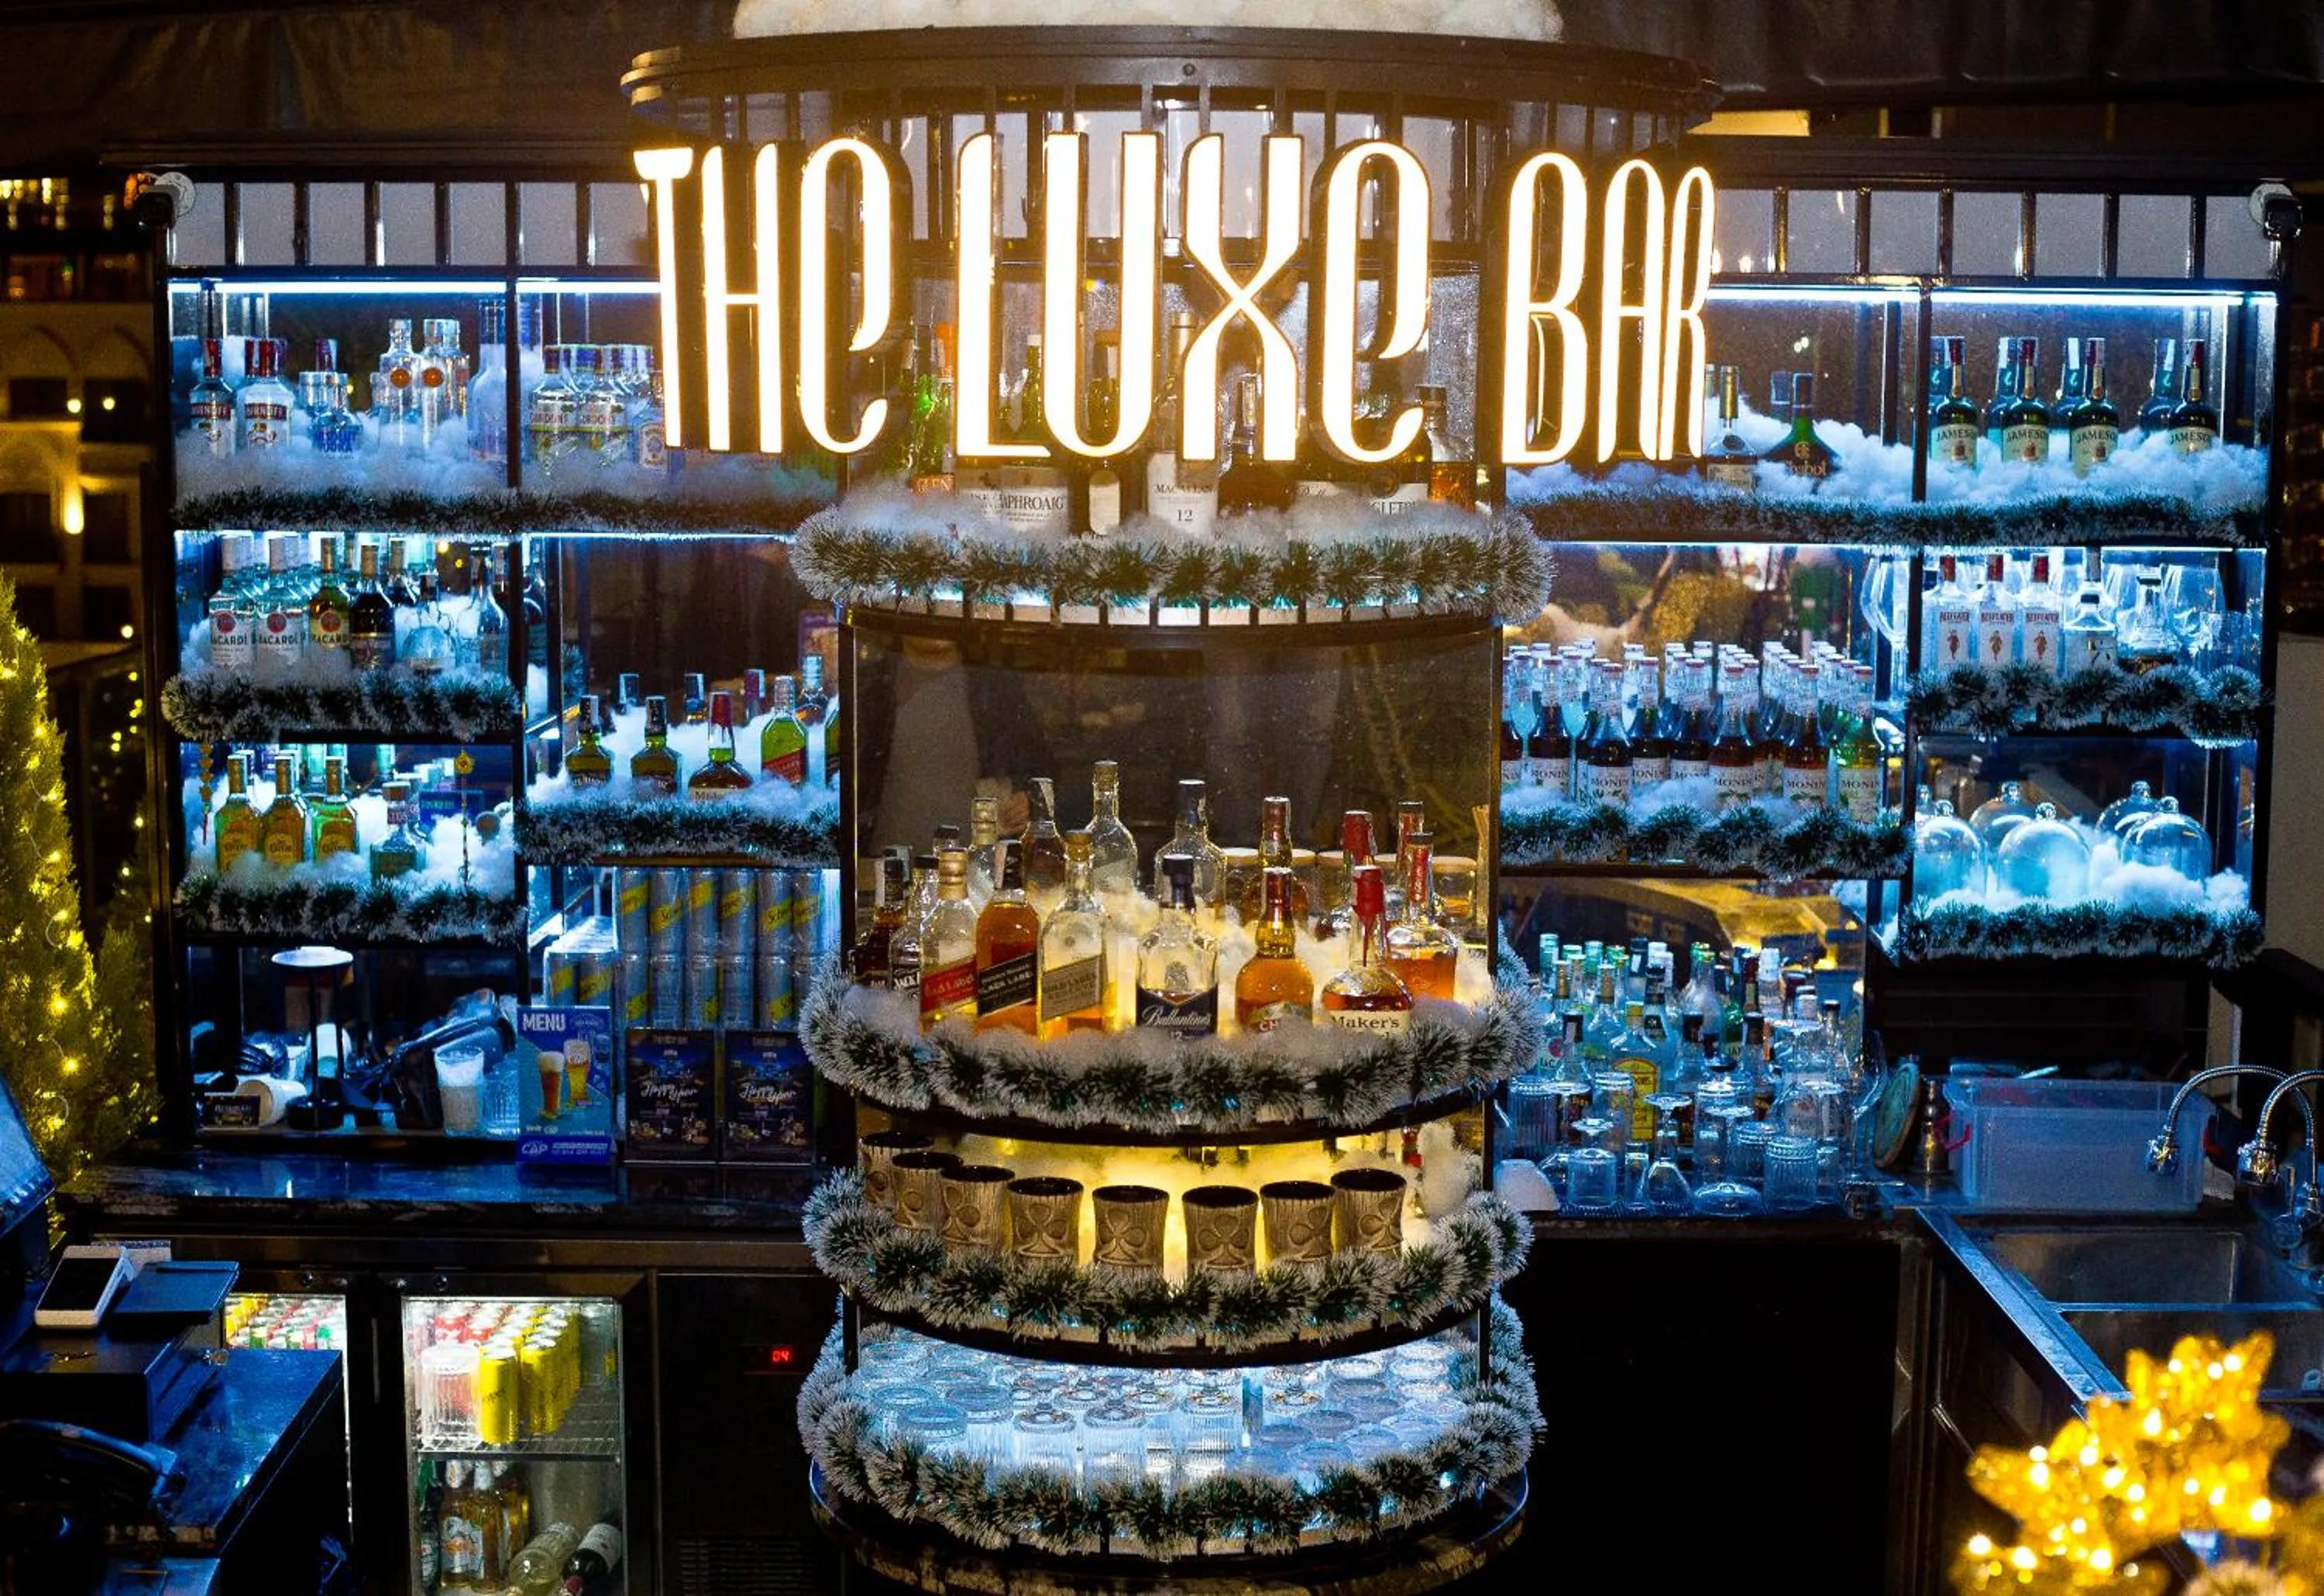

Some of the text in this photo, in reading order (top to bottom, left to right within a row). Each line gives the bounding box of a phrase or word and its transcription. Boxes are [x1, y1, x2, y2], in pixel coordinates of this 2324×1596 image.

[1501, 153, 1716, 464] BAR
[2006, 428, 2047, 442] JAMESO
[2076, 429, 2115, 443] JAMESO
[2170, 431, 2209, 444] JAMESO
[999, 493, 1066, 511] APHROAIG
[1176, 509, 1194, 522] 12
[522, 1013, 566, 1032] MENU
[1141, 1005, 1212, 1028] Ballantine's
[1331, 1015, 1401, 1029] Maker's
